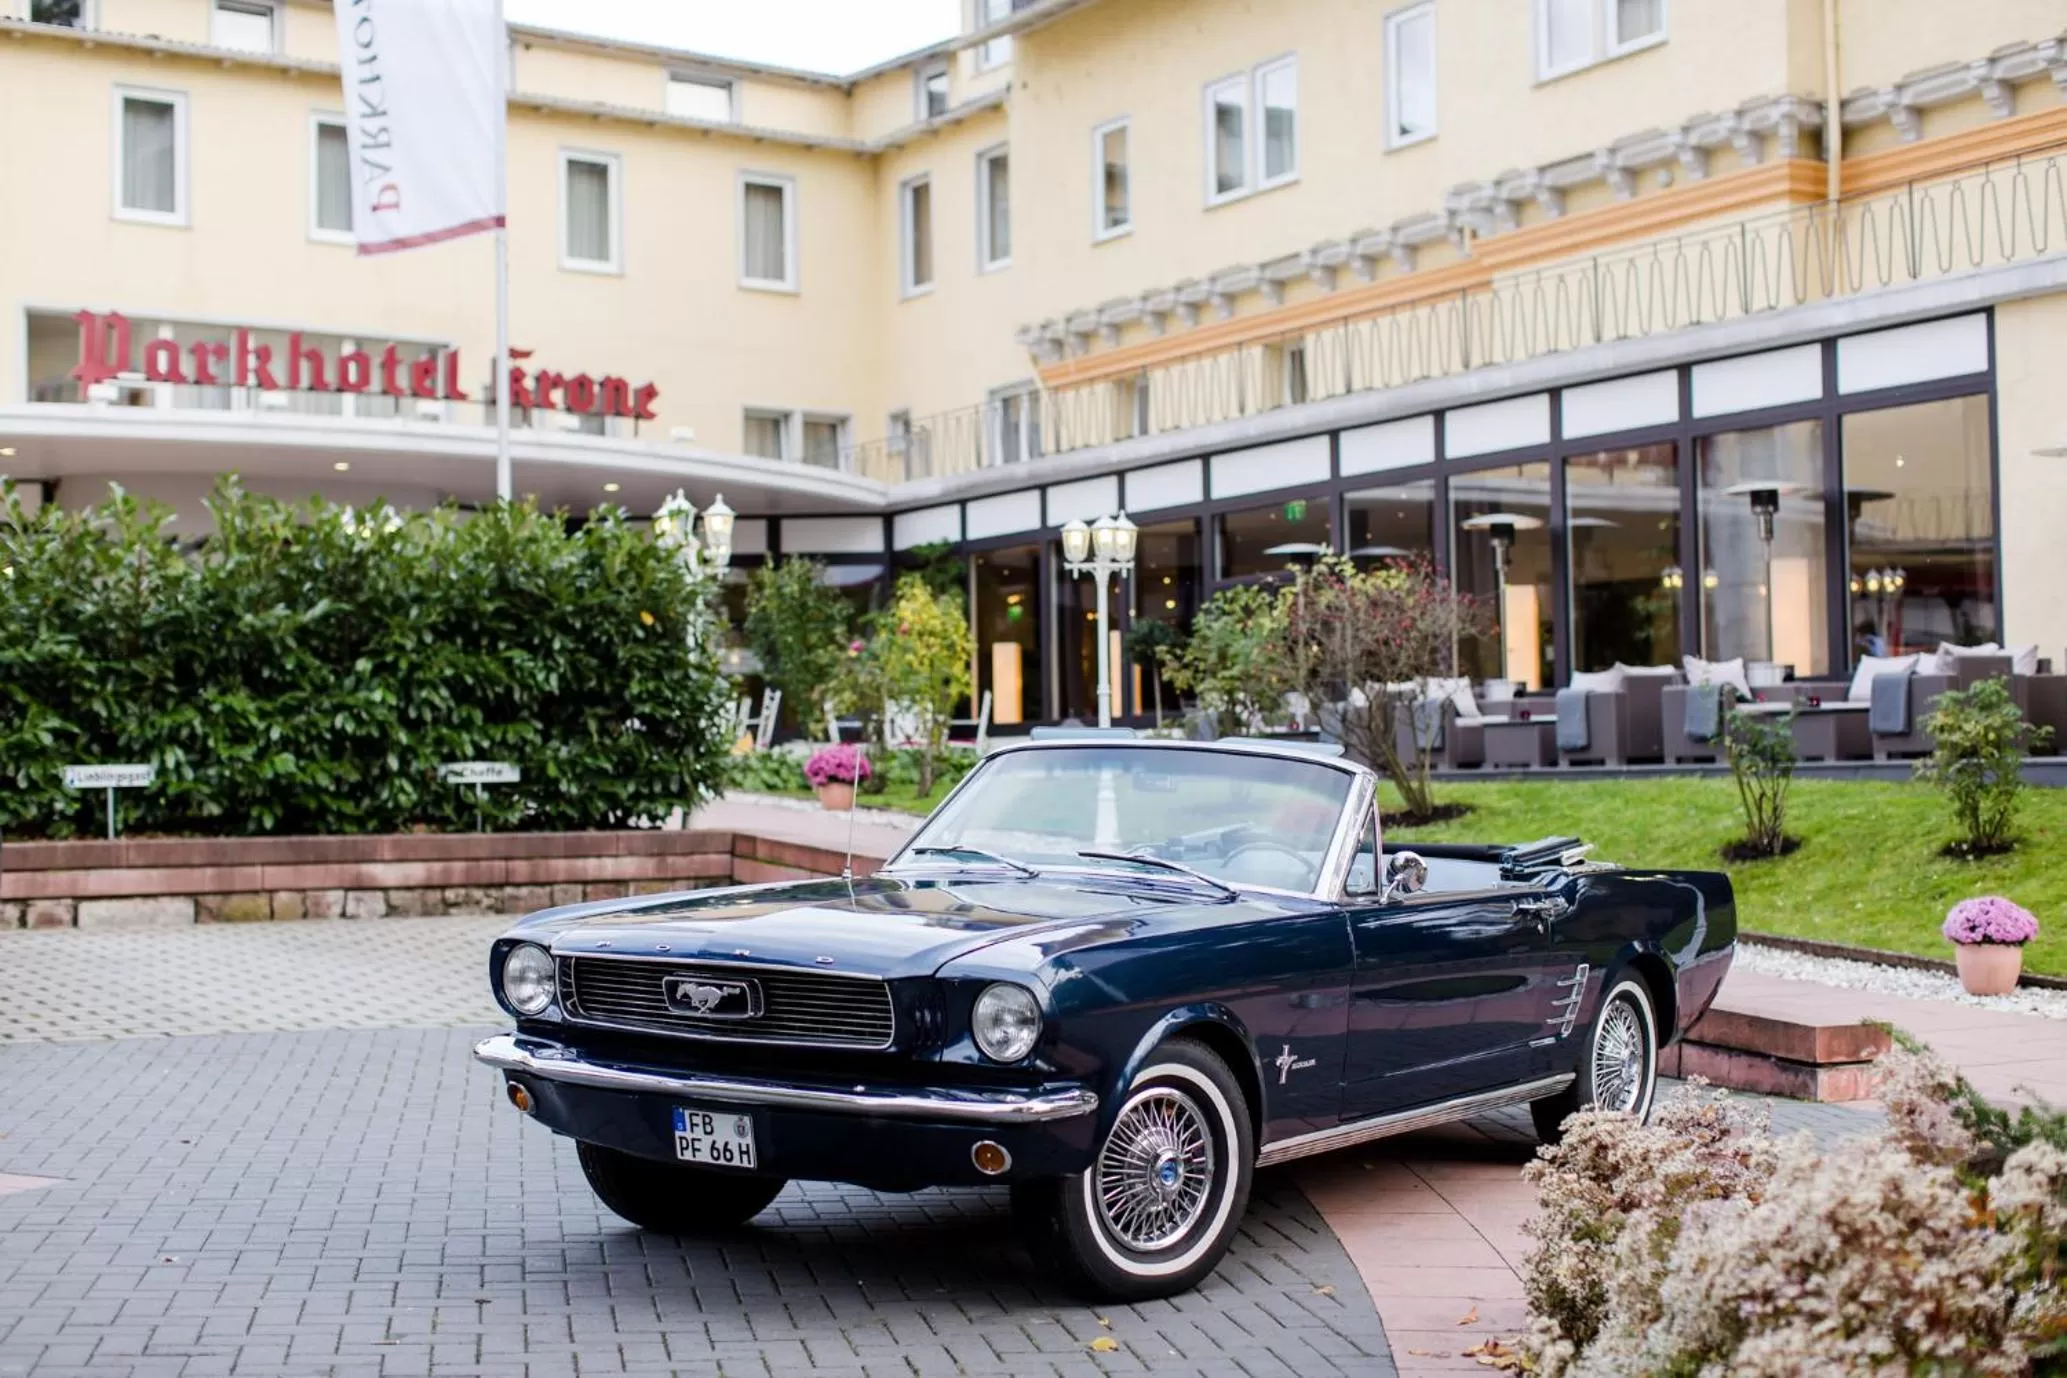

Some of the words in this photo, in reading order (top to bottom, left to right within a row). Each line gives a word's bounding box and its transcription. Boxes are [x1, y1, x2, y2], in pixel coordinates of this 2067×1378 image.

[71, 308, 468, 401] Parkhotel
[689, 1112, 714, 1135] FB
[678, 1136, 702, 1158] PF
